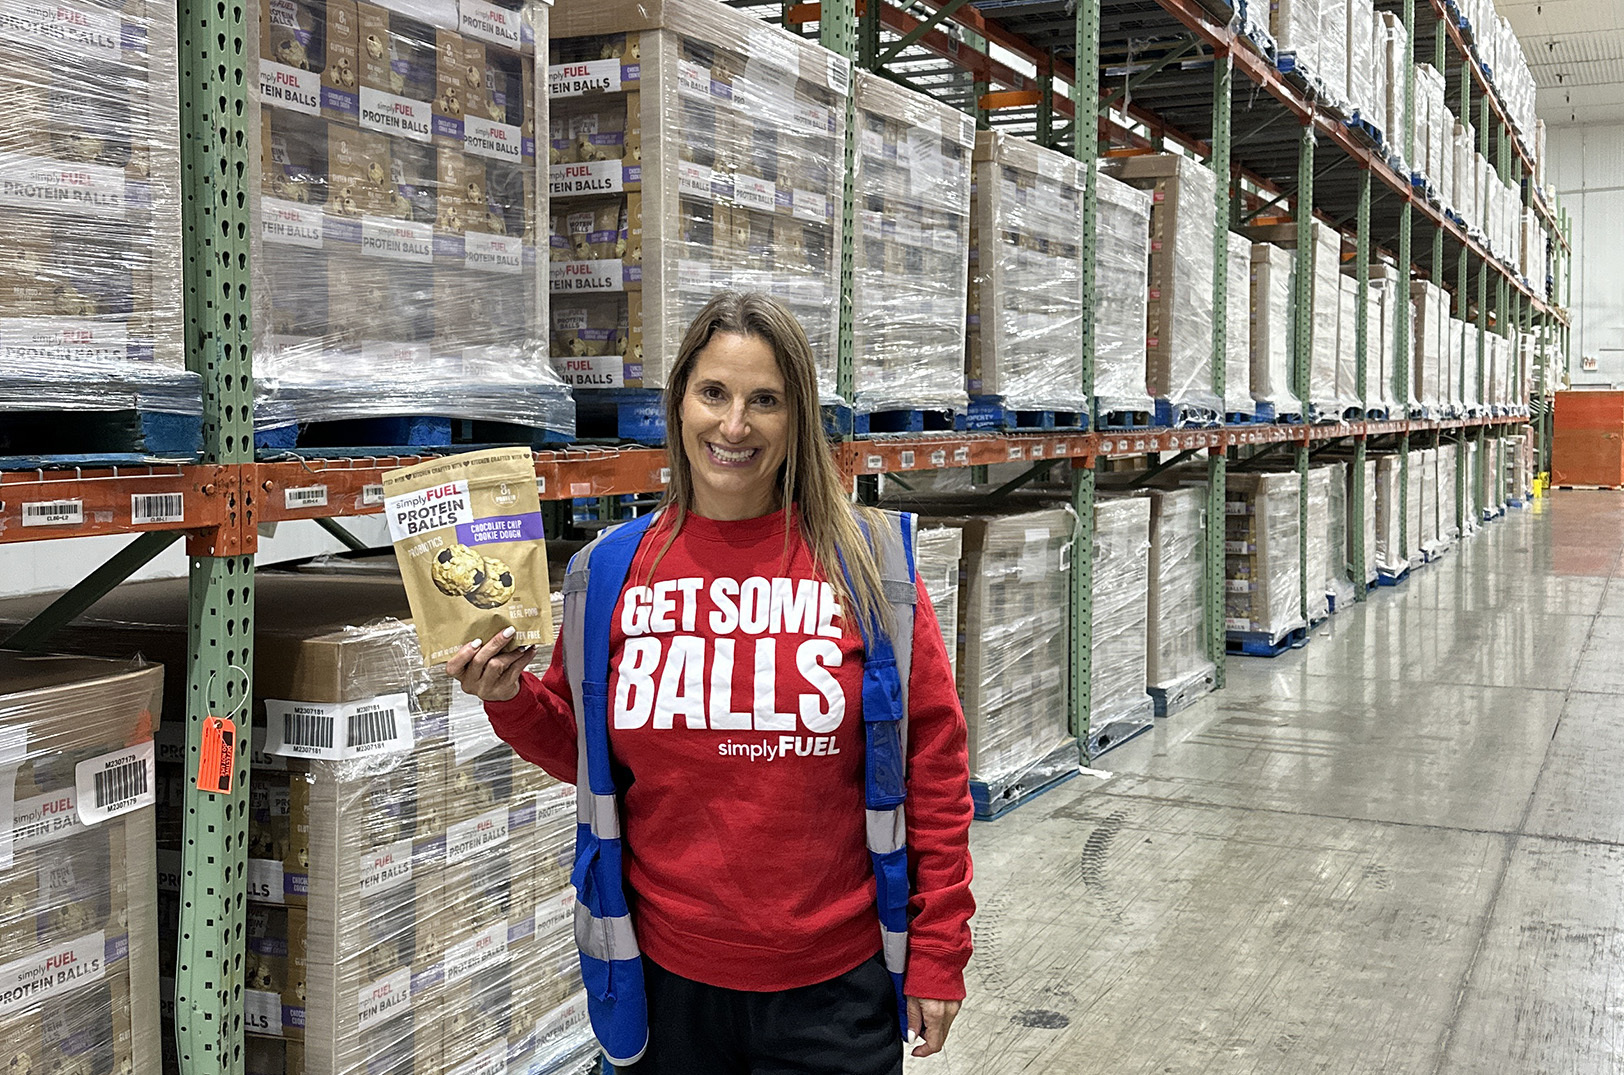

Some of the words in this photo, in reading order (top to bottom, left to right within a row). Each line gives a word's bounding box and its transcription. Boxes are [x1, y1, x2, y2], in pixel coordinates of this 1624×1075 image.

[475, 10, 506, 25] simplyFUEL
[463, 15, 494, 34] PROTEIN
[495, 26, 519, 41] BALLS
[260, 72, 300, 88] mplyFUEL
[549, 66, 590, 81] mplyFUEL
[549, 82, 571, 94] TEIN
[574, 78, 610, 92] BALLS
[690, 80, 709, 94] BALLS
[260, 83, 282, 99] TEIN
[285, 89, 317, 108] BALLS
[377, 102, 415, 117] simplyFUEL
[363, 110, 400, 128] PROTEIN
[402, 119, 429, 134] BALLS
[475, 127, 507, 141] simplyFUEL
[496, 140, 519, 156] BALLS
[30, 171, 94, 187] simplyFUEL
[549, 166, 592, 181] mplyFUEL
[549, 181, 572, 194] TEIN
[575, 178, 612, 191] BALLS
[691, 177, 710, 192] BALLS
[4, 181, 68, 200] PROTEIN
[73, 191, 119, 206] BALLS
[262, 221, 284, 236] TEIN
[286, 225, 319, 240] BALLS
[363, 237, 400, 252] PROTEIN
[402, 242, 430, 256] BALLS
[496, 254, 519, 266] BALLS
[549, 264, 592, 279] mplyFUEL
[549, 278, 572, 290] TEIN
[575, 277, 612, 288] BALLS
[576, 374, 613, 385] BALLS
[431, 465, 451, 474] CRAFTED
[451, 462, 463, 470] WITH
[471, 458, 490, 466] KITCHEN
[490, 455, 511, 463] CRAFTED
[396, 484, 462, 509] simplyFUEL
[397, 499, 464, 525] PROTEIN
[407, 513, 458, 535] BALLS
[470, 520, 506, 533] CHOCOLATE
[507, 519, 522, 530] CHIP
[474, 531, 498, 542] COOKIE
[499, 530, 522, 539] DOUGH
[408, 536, 444, 558] PROBIOTICS
[509, 609, 524, 619] REAL
[620, 577, 704, 636] GET
[708, 576, 843, 639] SOME
[526, 630, 541, 640] FREE
[613, 635, 846, 734] BALLS
[294, 707, 324, 715] M2307181
[356, 704, 380, 714] M2307181
[293, 746, 321, 754] M2307181
[356, 743, 385, 752] M2307181
[718, 735, 841, 762] simplyFUEL
[105, 755, 136, 768] M2307179
[13, 798, 74, 824] simplyFUEL
[107, 798, 137, 812] M2307179
[53, 814, 81, 831] BAL
[449, 839, 482, 858] PROTEIN
[482, 826, 506, 844] BALLS
[360, 873, 379, 889] TEIN
[381, 862, 409, 880] BALLS
[18, 950, 78, 982] simplyFUEL
[57, 958, 99, 985] BALLS
[358, 1004, 378, 1023] TEIN
[379, 989, 407, 1012] BALLS
[565, 1010, 586, 1030] BALLS
